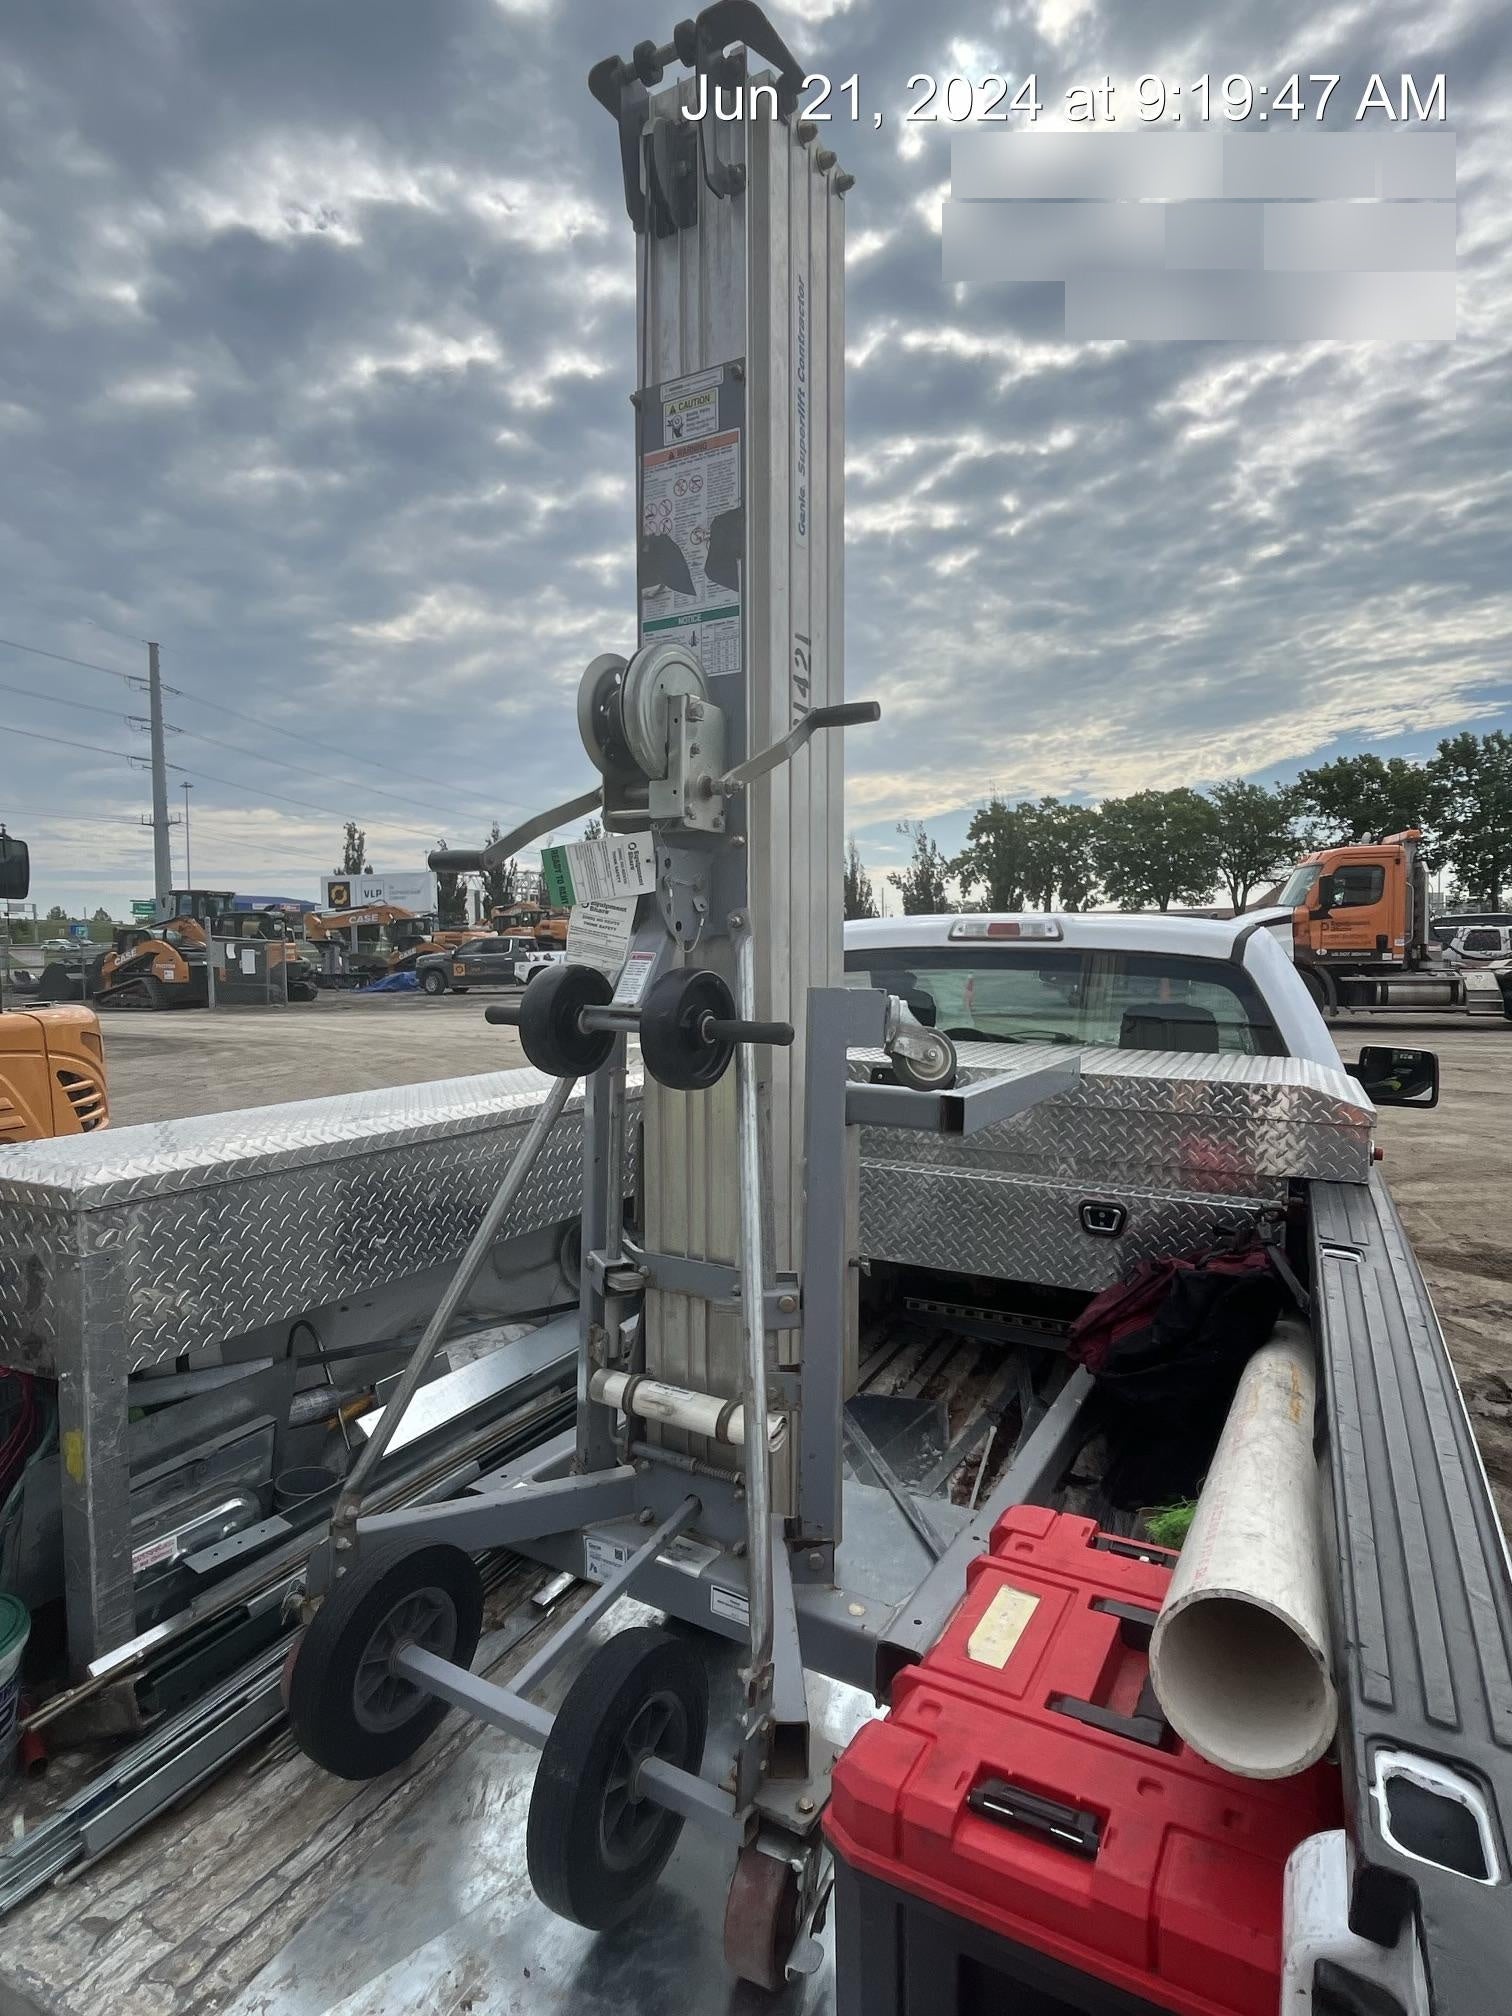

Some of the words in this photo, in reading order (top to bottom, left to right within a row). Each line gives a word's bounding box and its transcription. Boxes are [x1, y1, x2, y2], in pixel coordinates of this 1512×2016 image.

[796, 275, 806, 383] Contractor
[678, 394, 710, 411] CAUTION
[678, 614, 703, 625] NOTICE
[550, 849, 563, 874] READY
[363, 889, 382, 898] VLP
[349, 913, 379, 924] CASE
[114, 947, 137, 967] CASE
